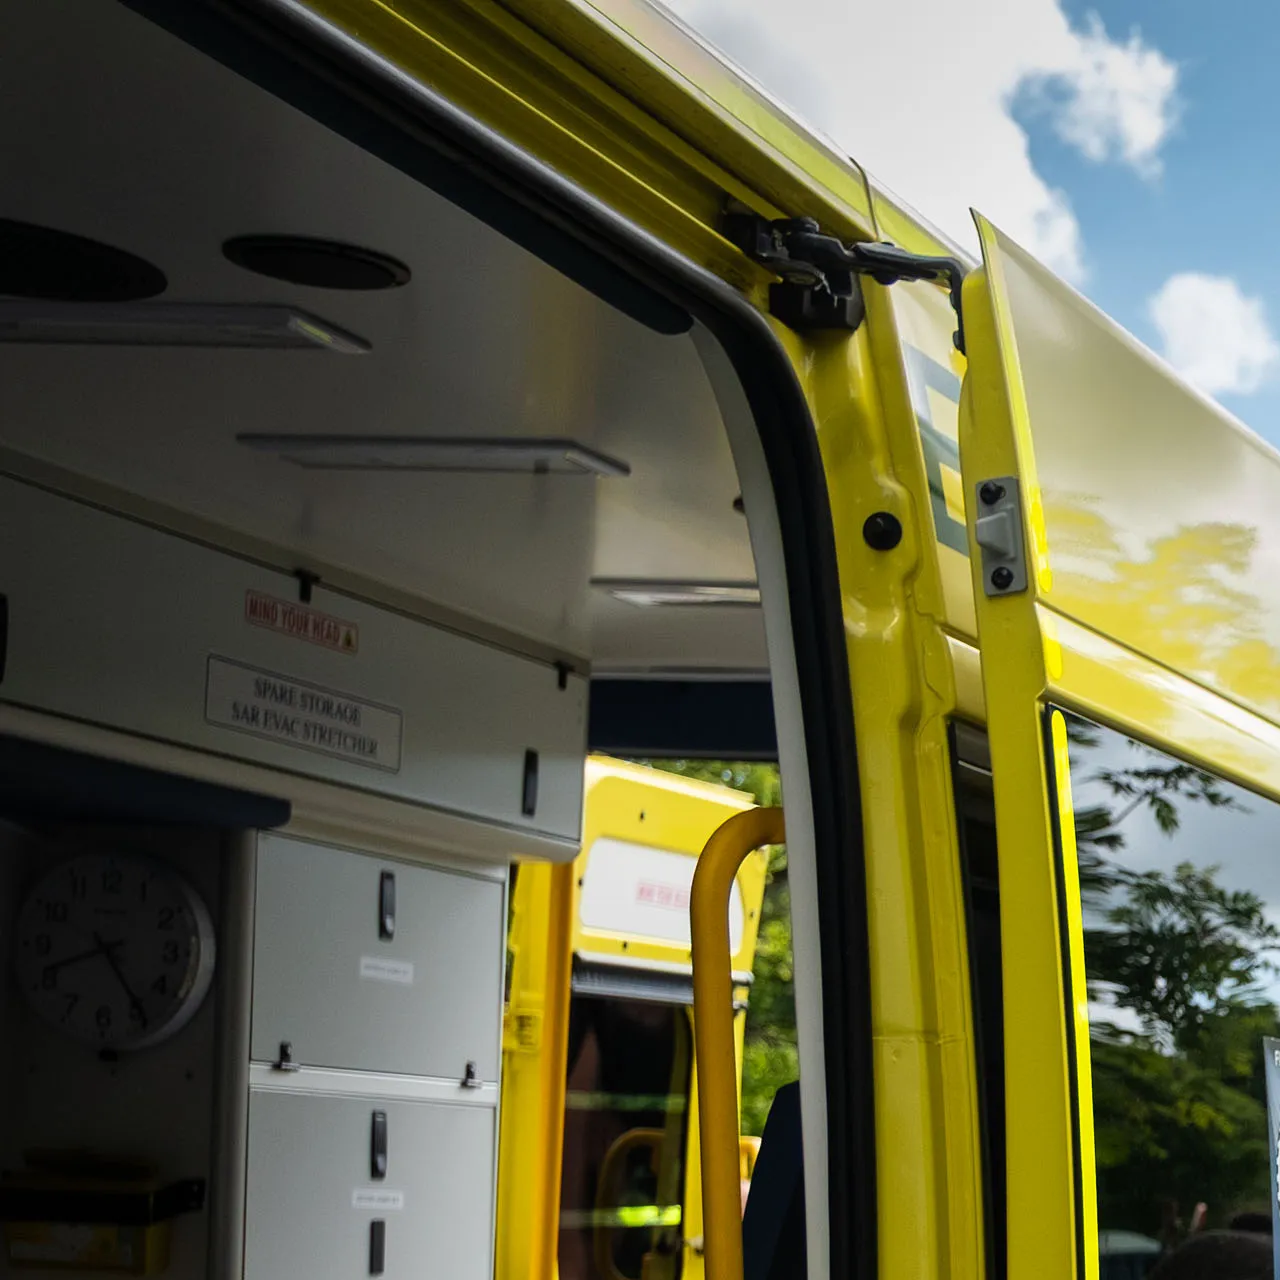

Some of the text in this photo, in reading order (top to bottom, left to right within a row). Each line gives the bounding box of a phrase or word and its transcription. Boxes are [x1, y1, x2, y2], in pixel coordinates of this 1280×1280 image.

[249, 597, 278, 622] MIND
[281, 605, 309, 634] YOUR
[254, 677, 361, 727] SPARE STORAGE
[231, 701, 378, 758] SAR EVAC STRETCHER
[158, 906, 175, 930] 2
[162, 940, 179, 964] 3
